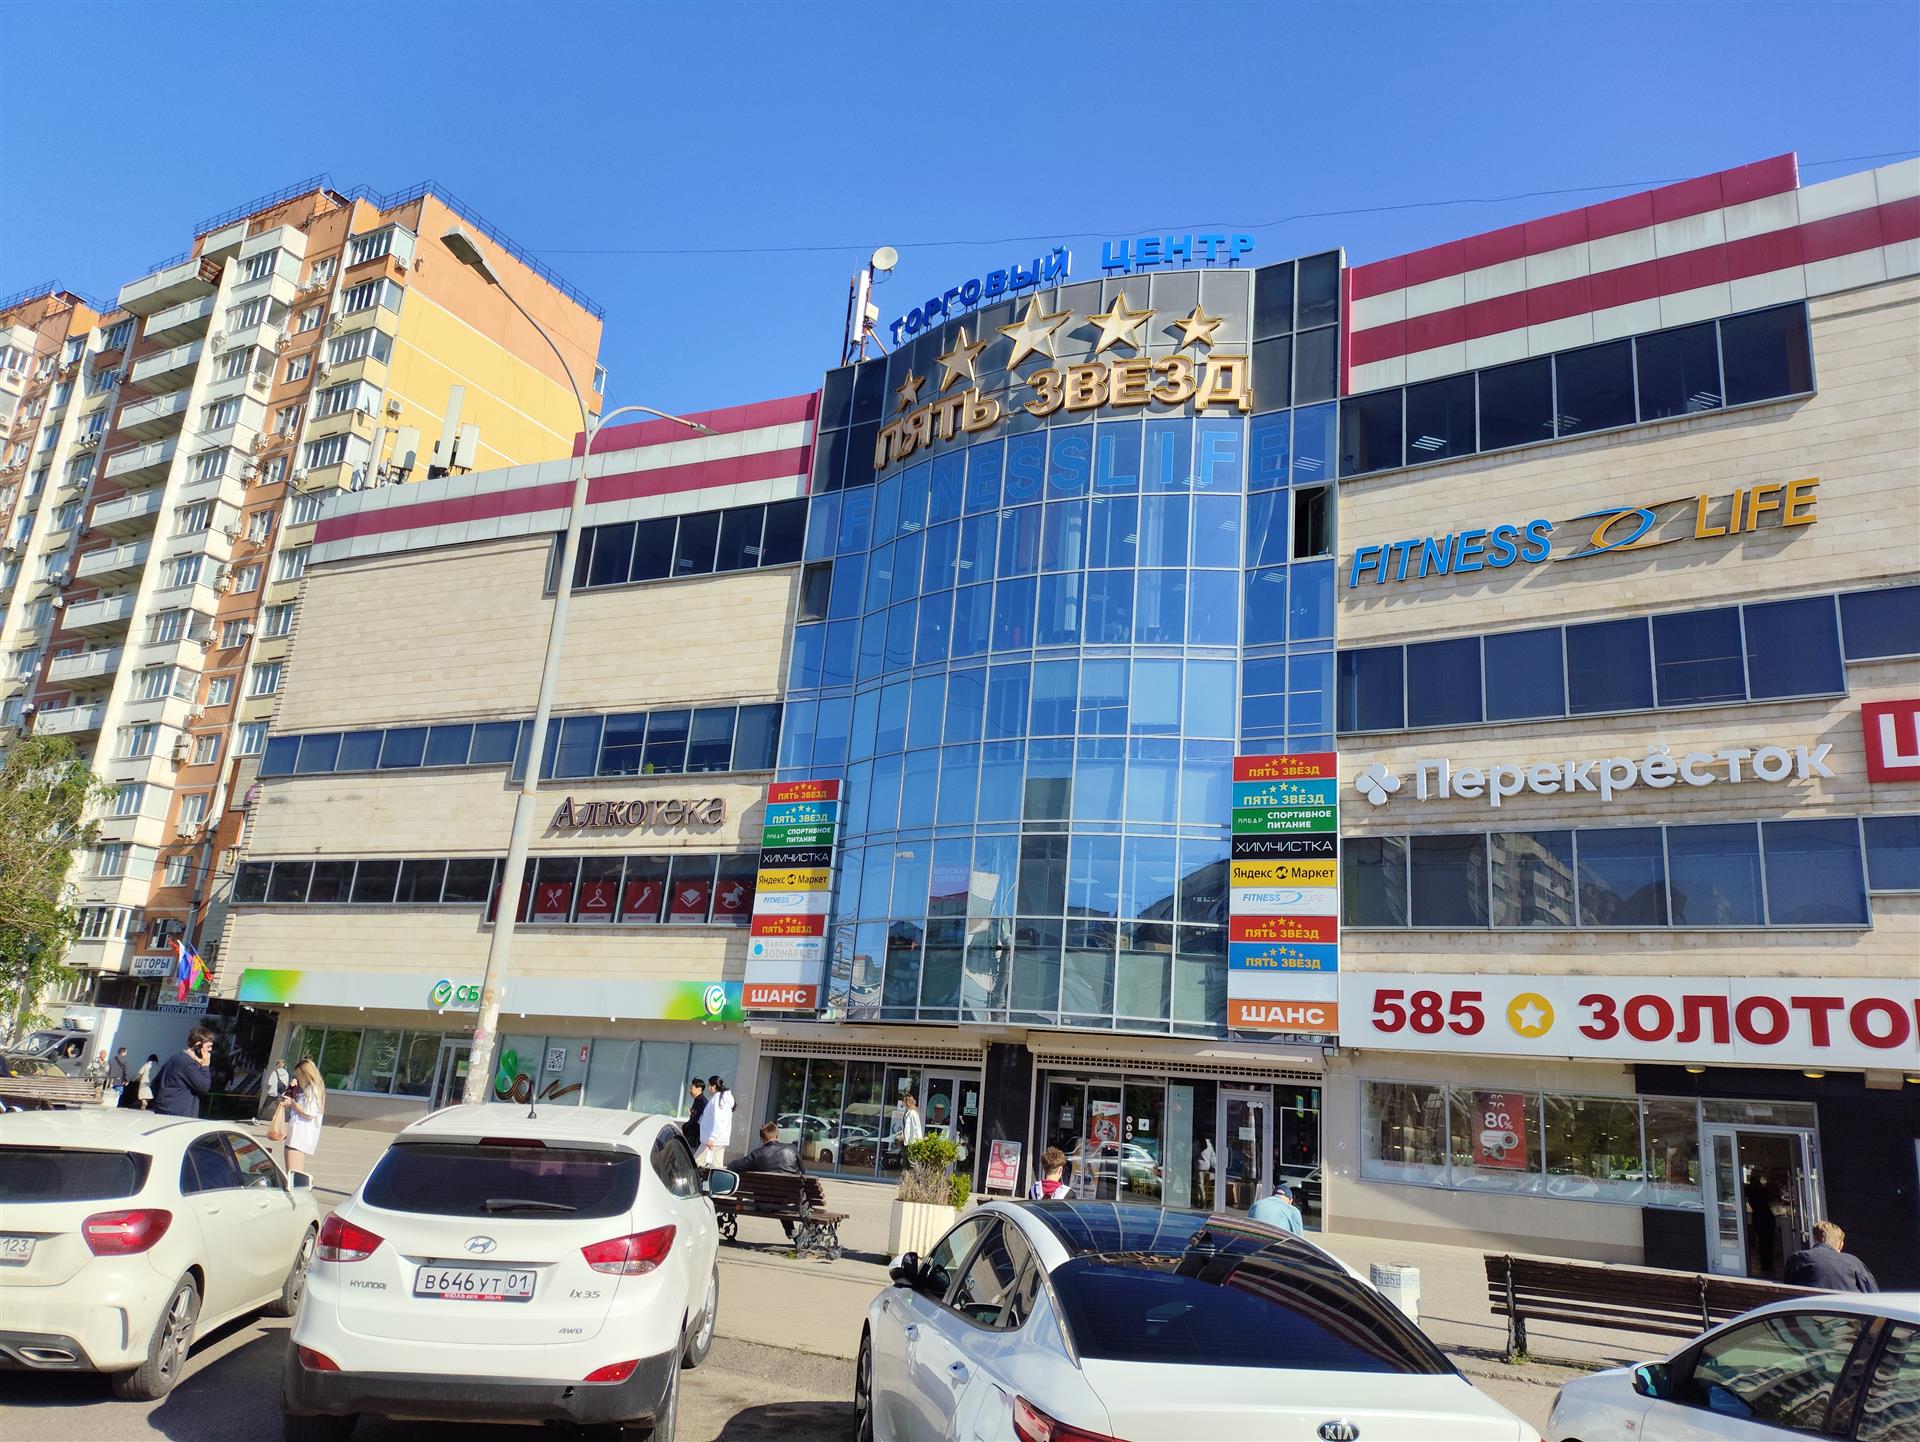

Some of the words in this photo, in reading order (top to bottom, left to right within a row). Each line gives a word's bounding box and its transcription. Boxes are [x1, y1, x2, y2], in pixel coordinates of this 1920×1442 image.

[889, 245, 1072, 346] ТОРГОВЫЙ
[1101, 234, 1255, 270] ЦЕНТР
[874, 387, 1000, 470] ПЯТЬ
[1024, 353, 1254, 417] ЗВЕЗД
[1349, 518, 1554, 588] FITNESS
[1694, 477, 1820, 539] LIFE
[1248, 768, 1279, 777] ПЯТЬ
[1282, 766, 1320, 776] ЗВЕЗД
[1414, 743, 1837, 808] Перекрёсток
[778, 792, 799, 800] ПЯТЬ
[800, 790, 827, 799] ЗВЕЗД
[1243, 795, 1278, 806] ПЯТЬ
[1281, 794, 1325, 805] ЗВЕЗД
[551, 796, 728, 828] Алкотека
[1267, 810, 1332, 819] СПОРТИВНОЕ
[772, 815, 796, 824] ПЯТЬ
[798, 813, 828, 823] ЗВЕЗД
[1267, 820, 1312, 829] ПИТАНИЕ
[787, 827, 831, 835] СПОРТИВНОЕ
[1235, 840, 1334, 853] ХИМЧИСТКА
[762, 852, 829, 863] ХИМЧИСТКА
[759, 875, 785, 884] Яндекс
[798, 875, 827, 884] Маркет
[1233, 867, 1273, 880] Яндекс
[1291, 867, 1335, 879] Маркет
[763, 896, 790, 904] FITNESS
[1243, 893, 1281, 902] FITNESS
[762, 926, 783, 934] ПЯТЬ
[785, 925, 812, 934] ЗВЕЗД
[1245, 929, 1277, 938] ПЯТЬ
[1280, 929, 1320, 939] ЗВЕЗД
[134, 958, 170, 969] ШТОРЫ
[1246, 957, 1278, 967] ПЯТЬ
[1281, 958, 1321, 969] ЗВЕЗД
[456, 985, 481, 1002] СБ
[751, 989, 807, 1004] ШАНС
[1241, 1005, 1325, 1025] ШАНС
[1371, 988, 1486, 1036] 585
[1578, 993, 1920, 1049] ЗОЛОТО
[3, 1238, 29, 1252] 123
[350, 1279, 387, 1290] HYUNDAI
[507, 1274, 527, 1290] 01
[1324, 1424, 1355, 1440] KIA
